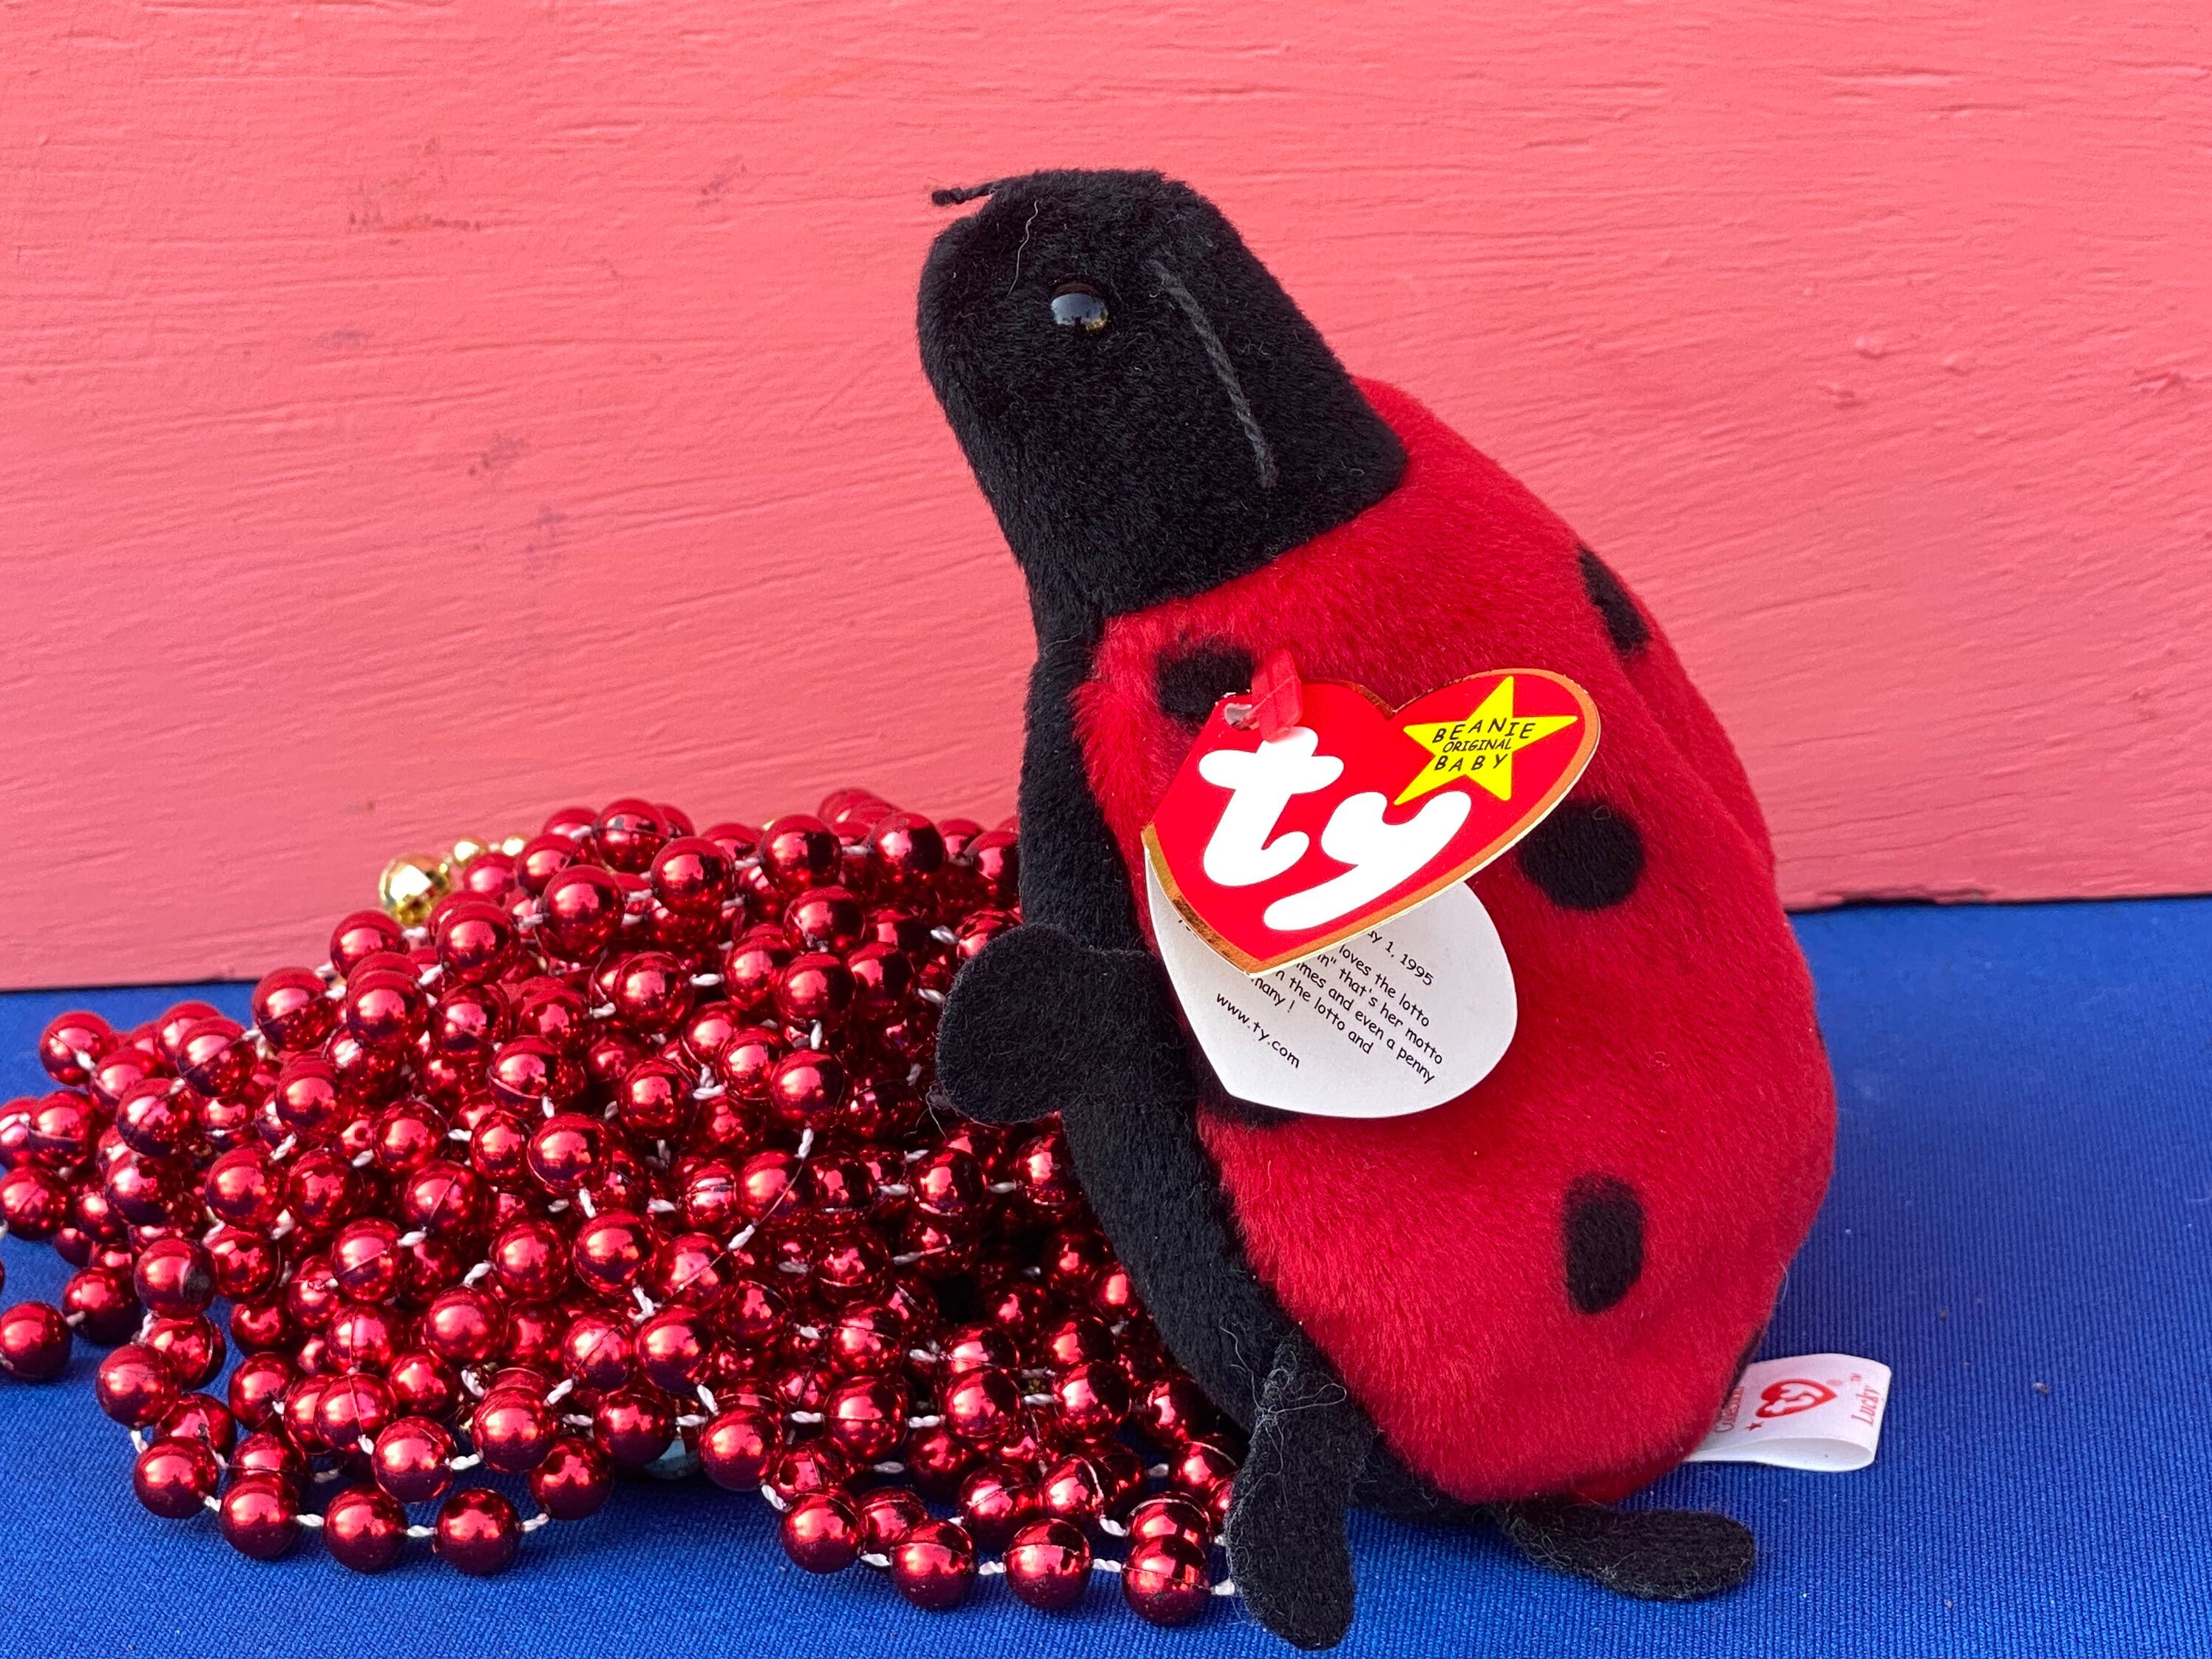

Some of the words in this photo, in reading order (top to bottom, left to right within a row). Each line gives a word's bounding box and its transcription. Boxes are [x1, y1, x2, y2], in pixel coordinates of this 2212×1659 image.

[1432, 717, 1536, 743] BEANIE
[1434, 753, 1508, 772] BABY
[1442, 738, 1512, 753] ORIGINAL
[1198, 726, 1471, 931] ty
[1339, 944, 1371, 976] loves
[1374, 973, 1397, 998] the
[1399, 993, 1430, 1027] lotto
[1400, 953, 1434, 985] 1995
[1217, 993, 1300, 1068] www.ty.com
[1289, 977, 1312, 1002] the
[1314, 997, 1346, 1031] lotto
[1348, 1031, 1374, 1054] and
[1296, 962, 1326, 988] mes
[1329, 988, 1354, 1011] and
[1355, 1011, 1384, 1040] even
[1386, 1038, 1396, 1050] a
[1397, 1047, 1436, 1085] penny
[1339, 968, 1378, 1007] that's
[1380, 1002, 1403, 1028] her
[1405, 1028, 1442, 1065] motto
[1851, 1384, 1880, 1426] Lucky
